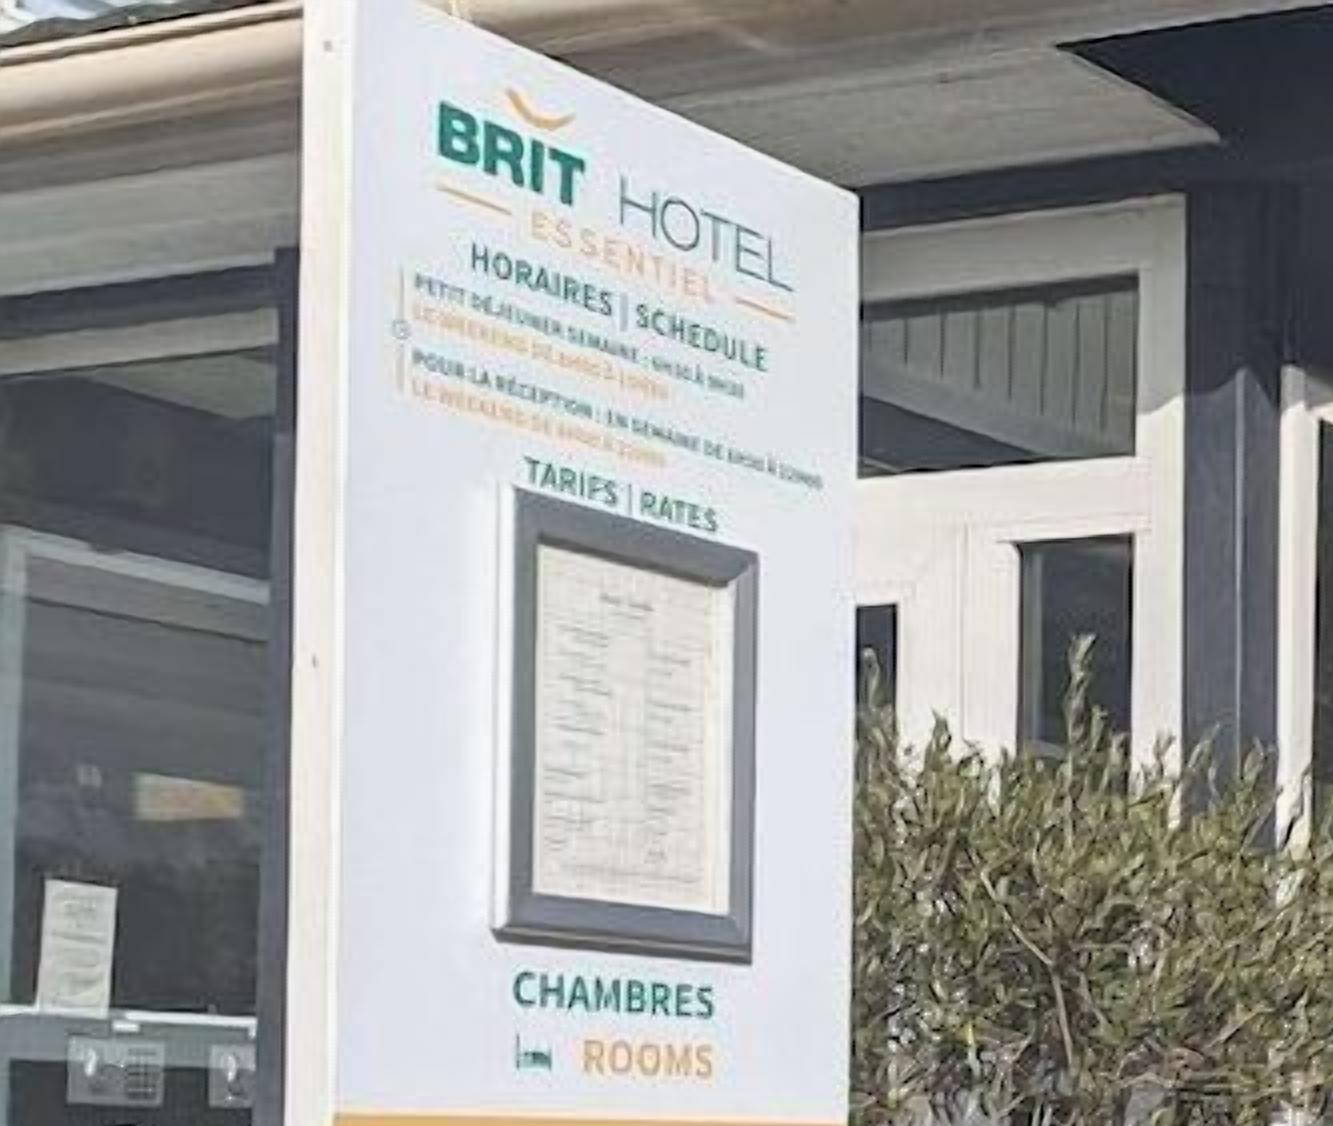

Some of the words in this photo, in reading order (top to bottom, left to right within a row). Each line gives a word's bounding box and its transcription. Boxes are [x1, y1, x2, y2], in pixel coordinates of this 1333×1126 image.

[438, 101, 585, 206] BRIT
[618, 173, 796, 293] HOTEL
[531, 211, 718, 303] ESSENTIEL
[470, 243, 613, 316] HORAIRES
[636, 303, 768, 373] SCHEDULE
[412, 348, 463, 378] POUR
[524, 456, 619, 507] TARIFS
[640, 489, 719, 533] RATES
[513, 971, 716, 1020] CHAMBRES
[582, 1039, 713, 1077] ROOMS
